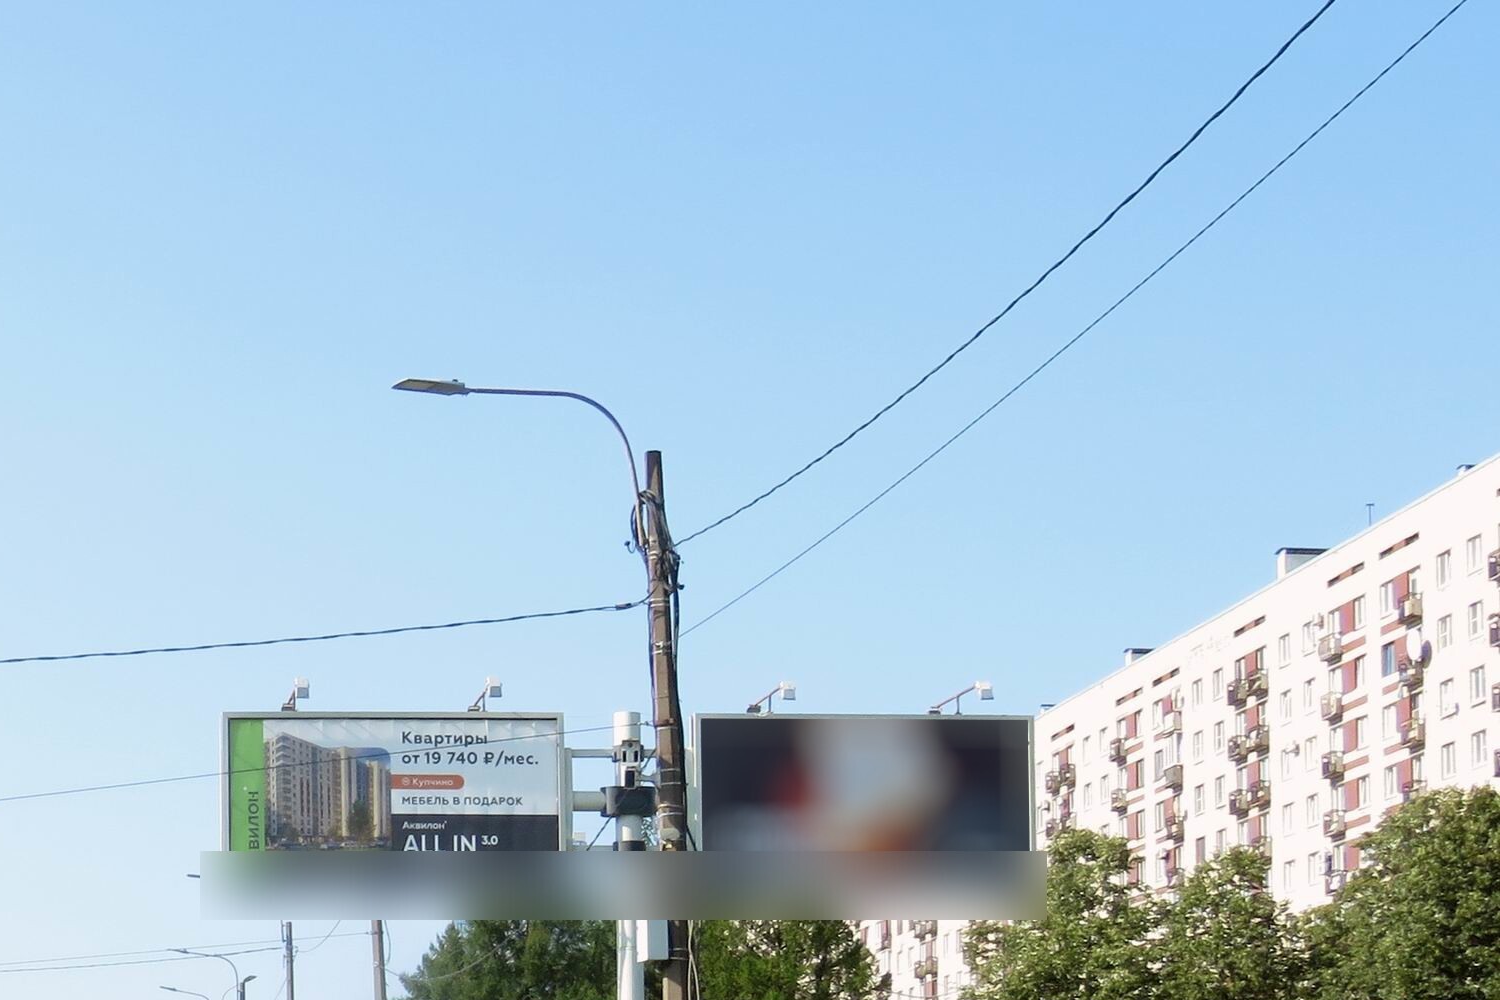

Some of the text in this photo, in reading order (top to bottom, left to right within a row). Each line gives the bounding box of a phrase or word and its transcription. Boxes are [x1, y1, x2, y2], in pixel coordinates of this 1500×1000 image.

[401, 731, 489, 747] Квартиры
[401, 754, 420, 765] от
[424, 751, 442, 765] 19
[446, 751, 478, 765] 740
[412, 778, 454, 788] Купчино
[401, 796, 524, 807] МЕБЕЛЬ В ПОДАРОК
[453, 834, 477, 852] IN
[481, 835, 499, 846] 3.0
